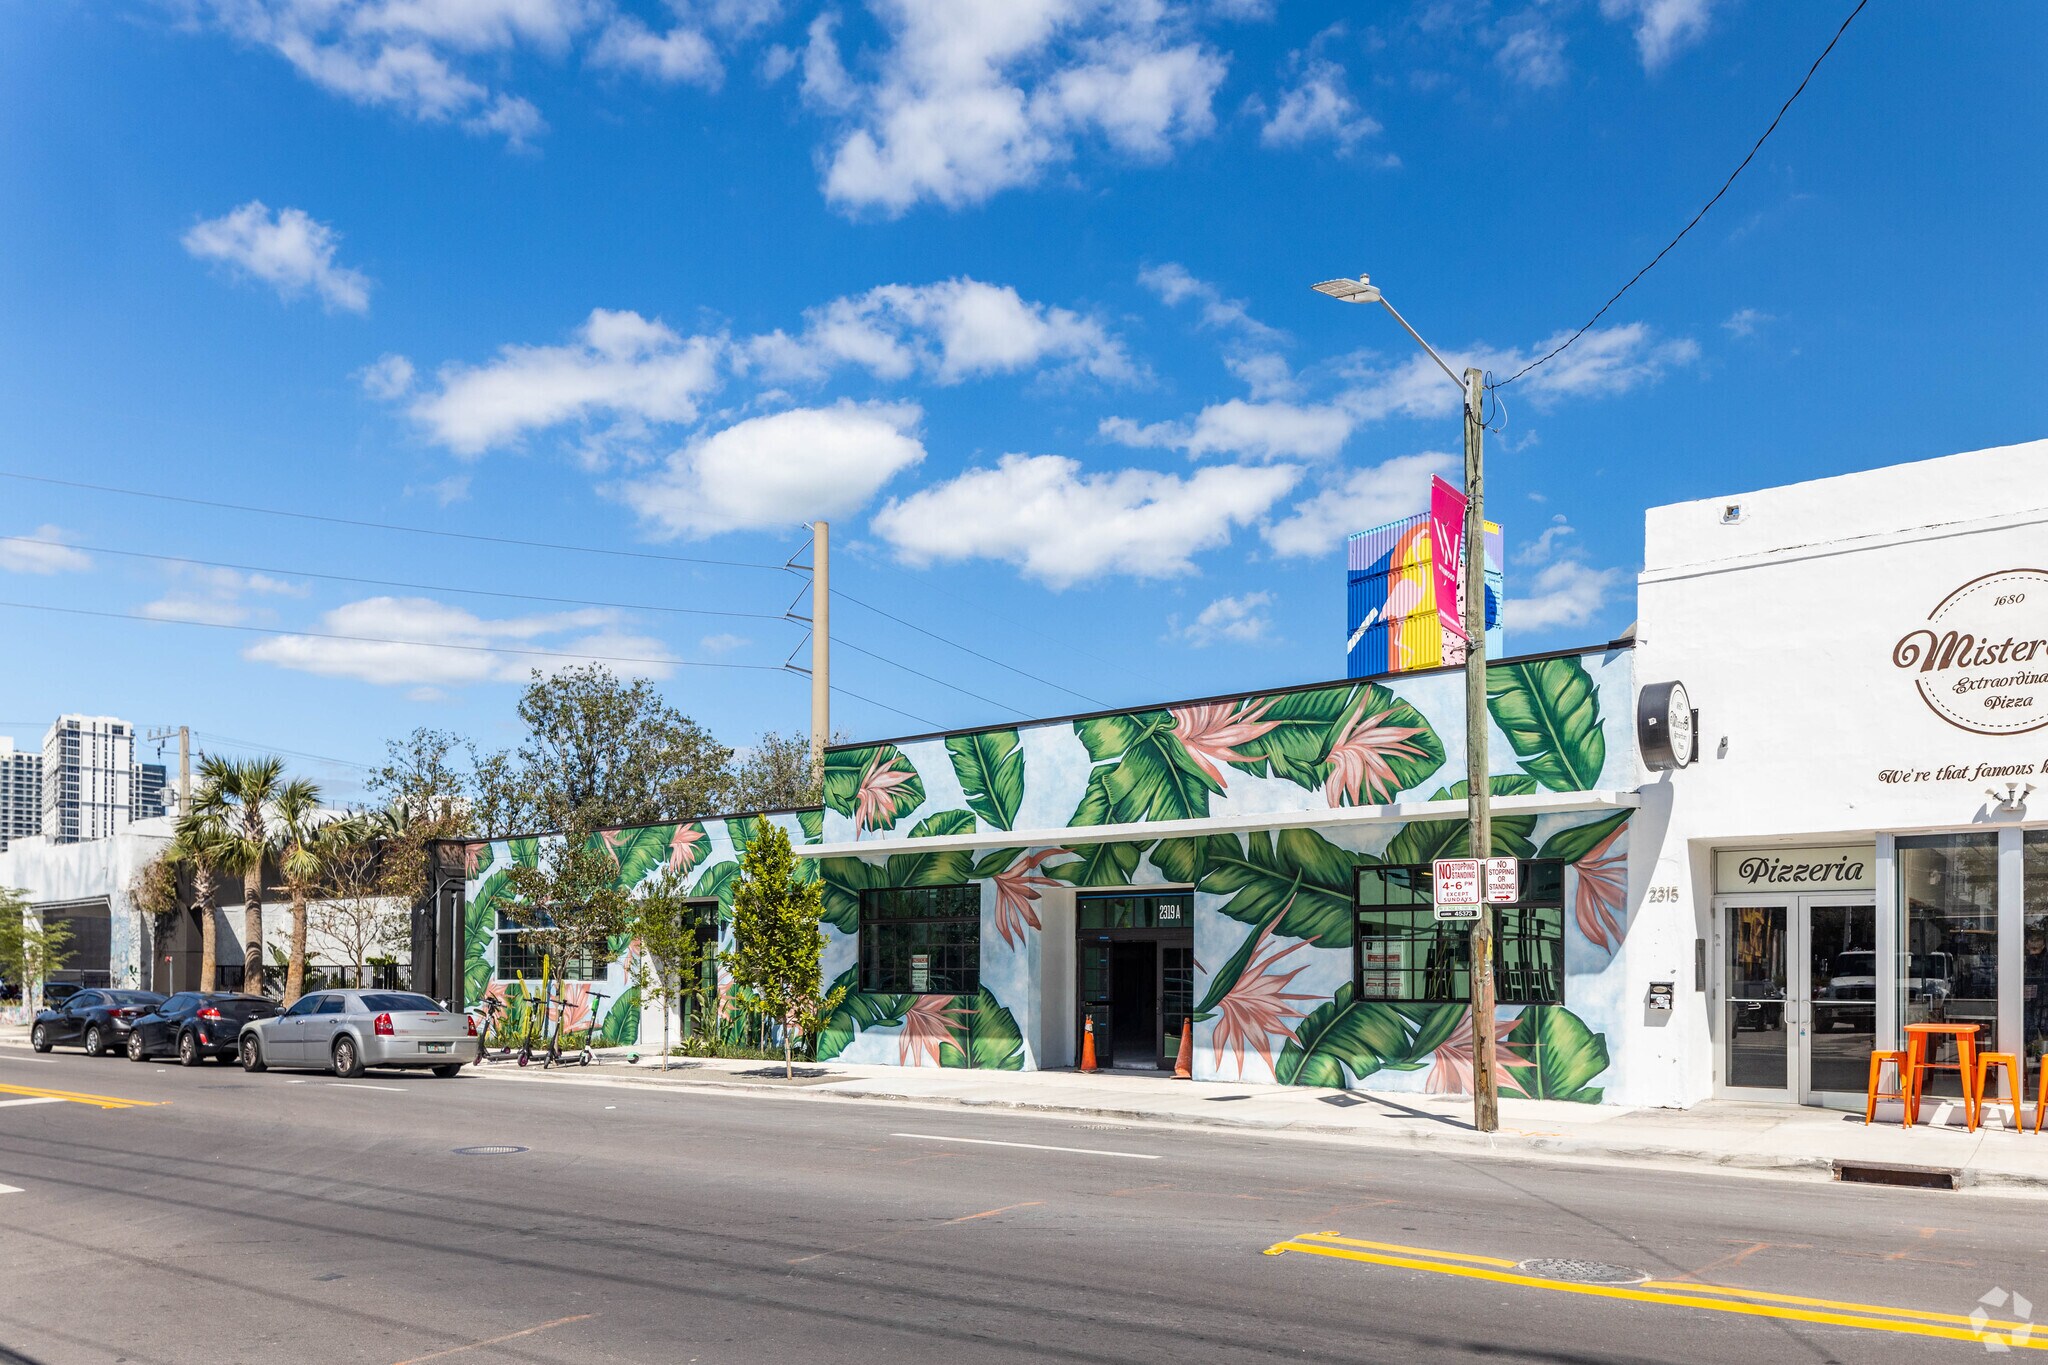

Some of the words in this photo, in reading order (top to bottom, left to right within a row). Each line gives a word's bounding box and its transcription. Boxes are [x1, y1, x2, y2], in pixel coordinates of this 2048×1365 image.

[1993, 593, 2026, 606] 1680
[1892, 629, 2048, 673] Mister
[1983, 695, 2034, 710] Pizza
[1878, 768, 1930, 784] We're
[1936, 764, 1970, 781] that
[1968, 762, 2035, 782] famous
[1439, 863, 1451, 880] NO
[1451, 863, 1475, 871] STOPPING
[1488, 868, 1515, 876] STOPPING
[1496, 861, 1507, 869] NO
[1738, 855, 1865, 885] Pizzeria
[1451, 871, 1475, 879] STANDING
[1497, 875, 1506, 883] OR
[1442, 881, 1463, 890] 4-6
[1648, 886, 1679, 904] 2315
[1159, 904, 1175, 919] 2319
[1175, 905, 1181, 919] A
